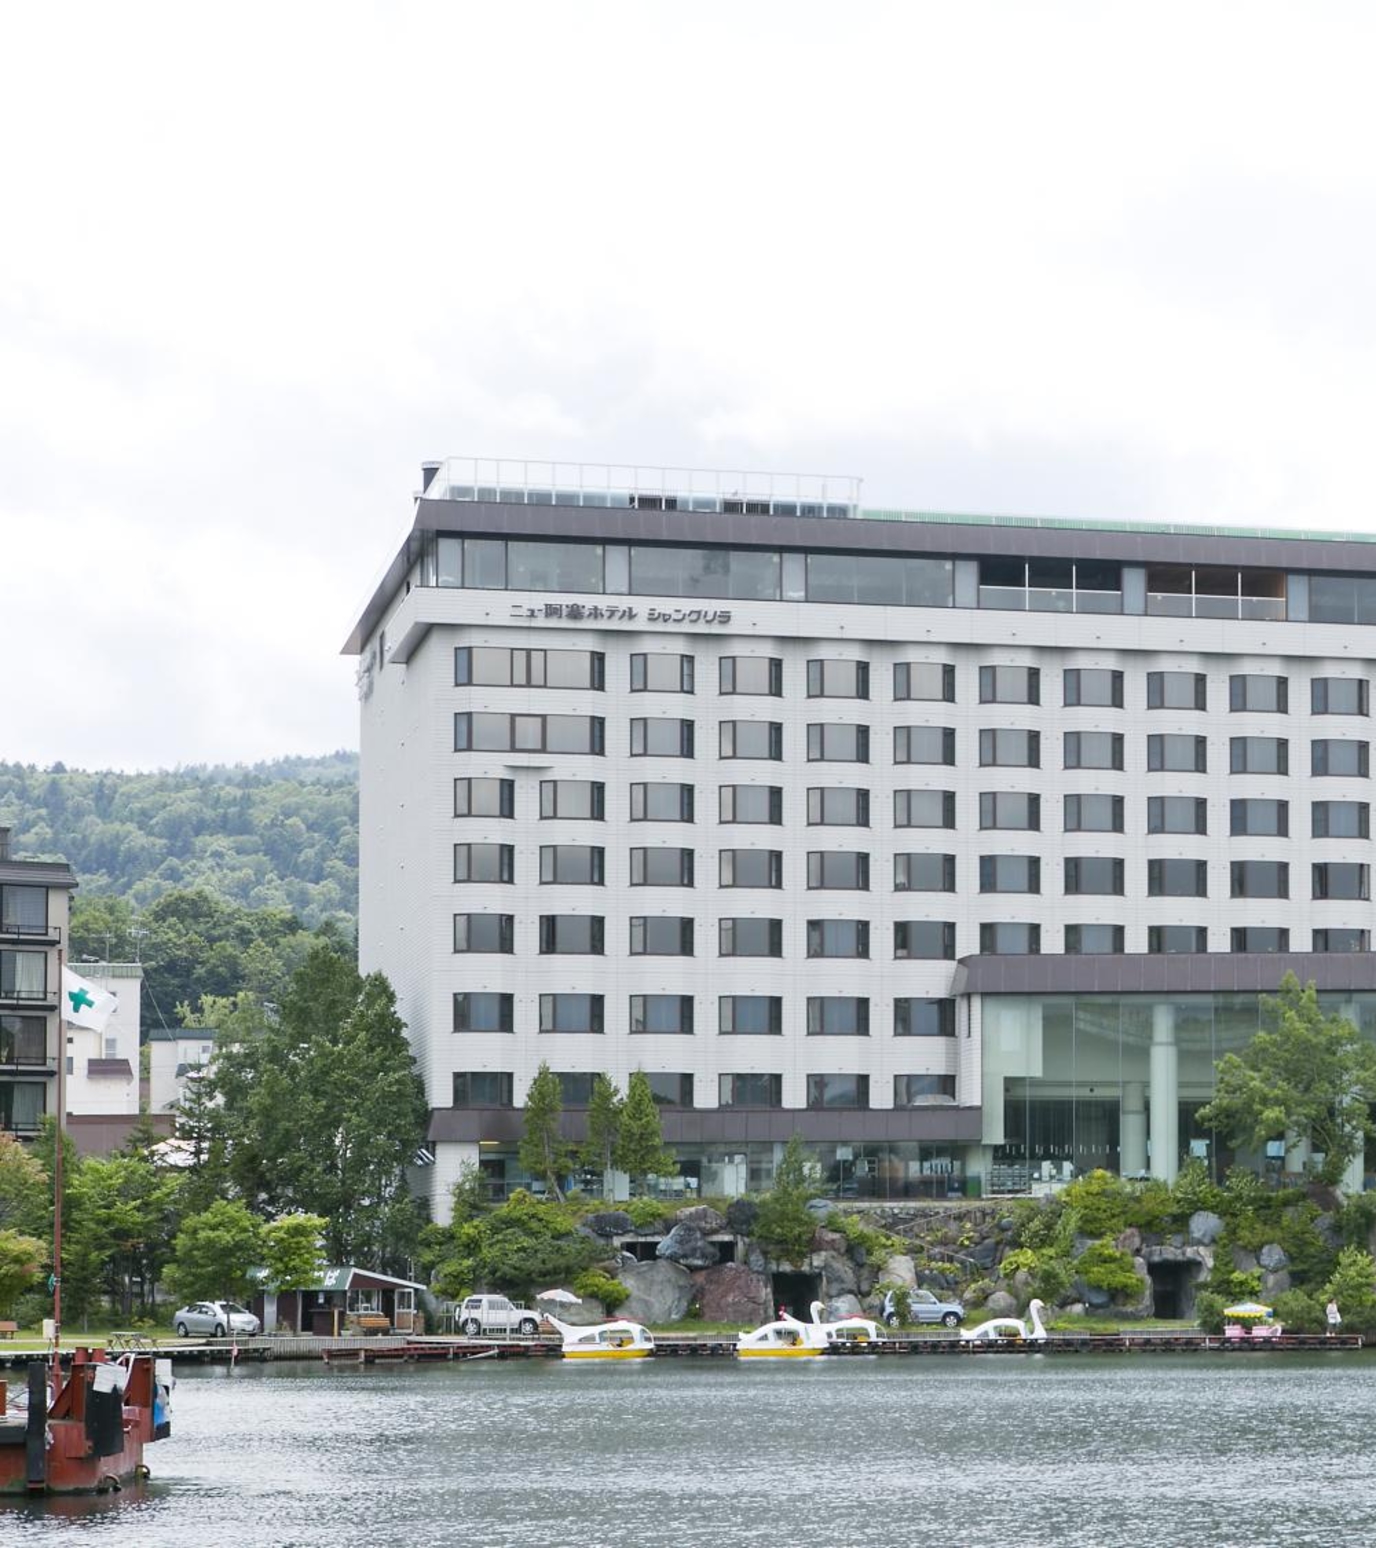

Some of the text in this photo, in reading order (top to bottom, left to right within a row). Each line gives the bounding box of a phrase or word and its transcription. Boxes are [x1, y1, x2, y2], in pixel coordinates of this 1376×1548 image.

[647, 607, 731, 624] シャングリラ
